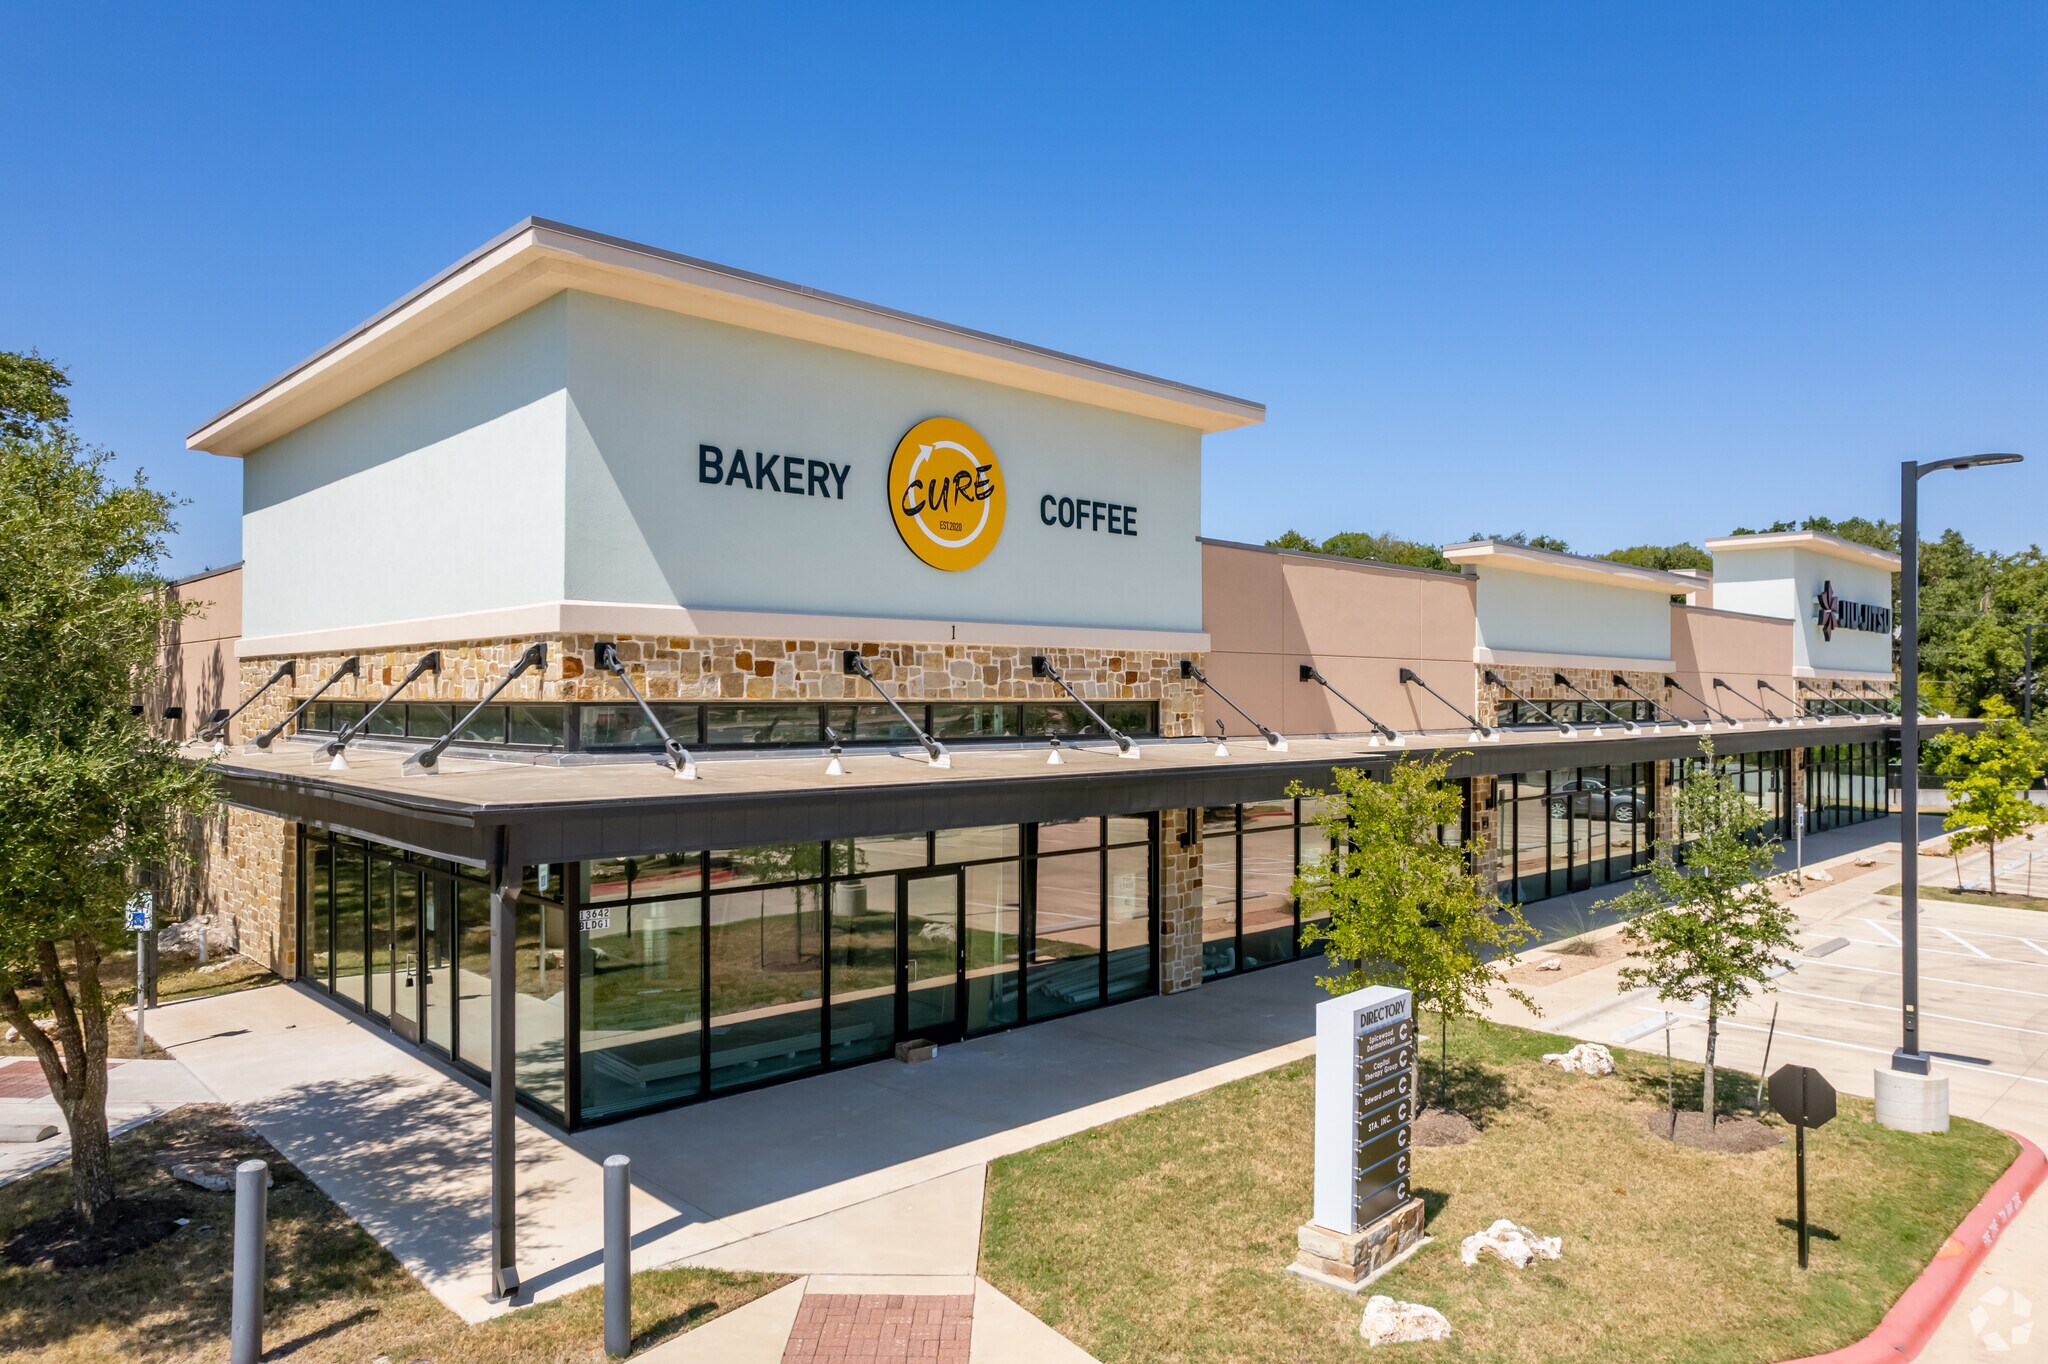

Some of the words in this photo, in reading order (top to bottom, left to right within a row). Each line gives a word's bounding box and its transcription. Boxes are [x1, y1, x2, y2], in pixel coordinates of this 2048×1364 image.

[698, 444, 852, 500] BAKERY
[902, 464, 994, 516] CURE
[1040, 494, 1138, 536] COFFEE
[1838, 600, 1890, 635] JIU-JITSU
[580, 908, 609, 920] 13642
[1360, 998, 1406, 1028] DIRECTORY
[1366, 1036, 1396, 1053] Dermatology
[1368, 1028, 1394, 1045] Spicewood
[1364, 1068, 1384, 1082] Therapy
[1384, 1063, 1398, 1074] Group
[1373, 1057, 1391, 1071] Capital
[1364, 1091, 1381, 1105] Edward
[1382, 1087, 1396, 1099] Jones
